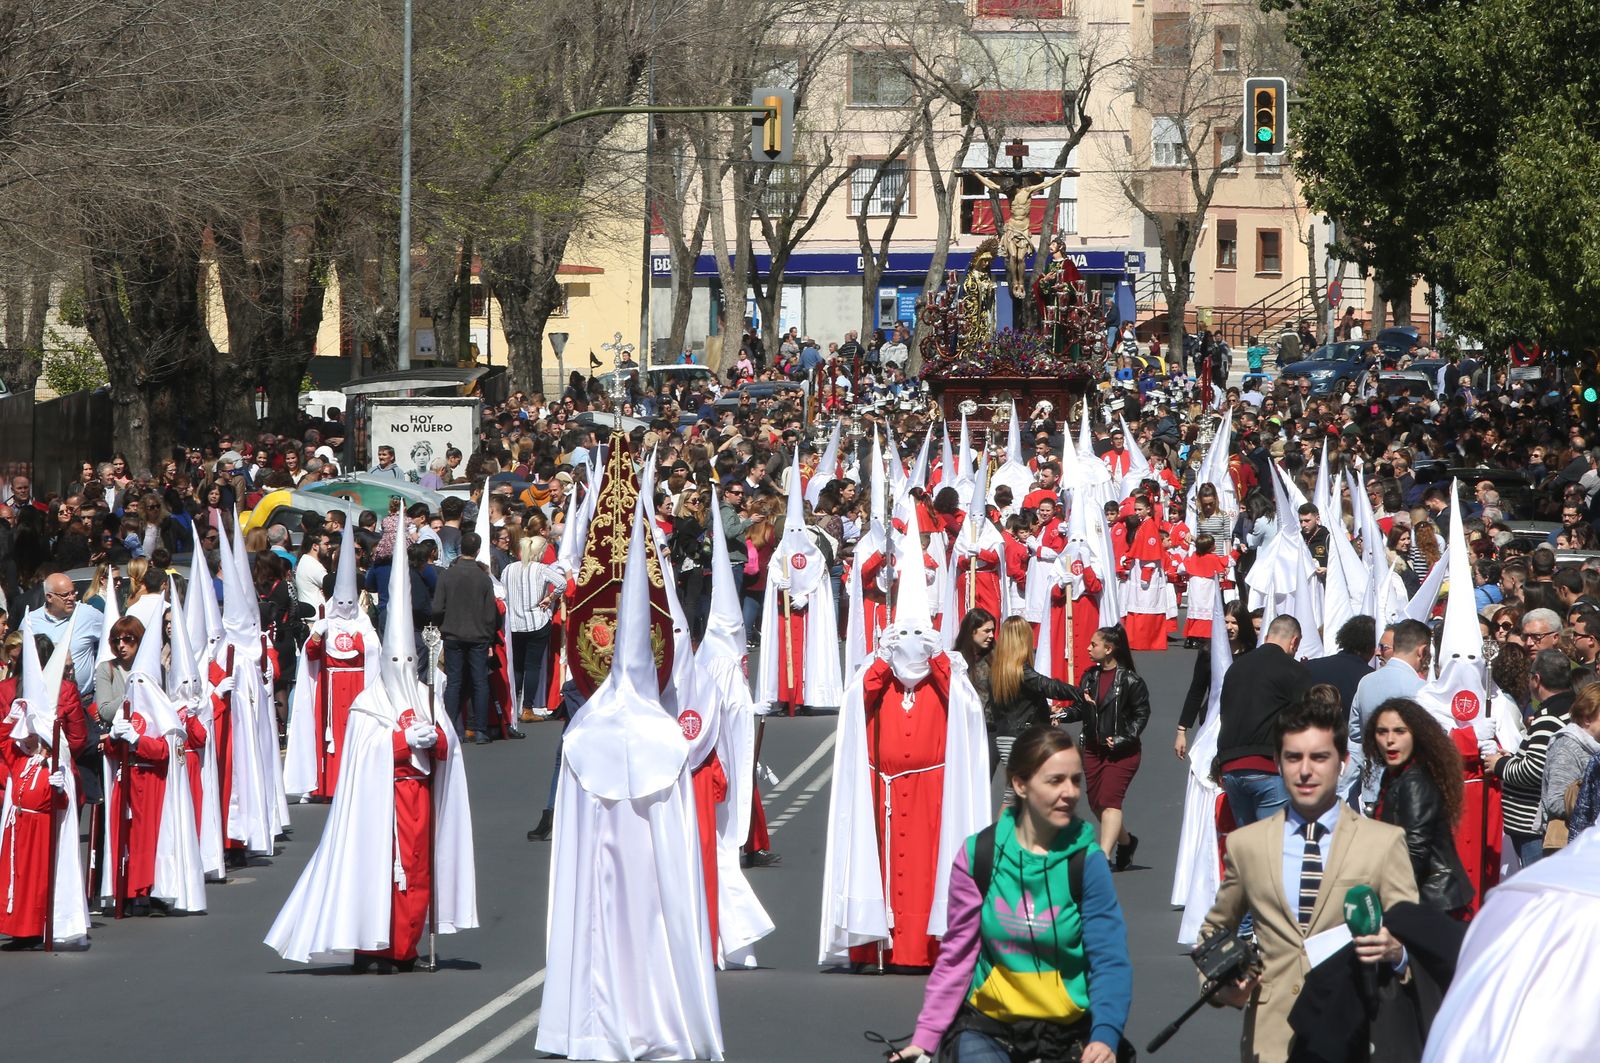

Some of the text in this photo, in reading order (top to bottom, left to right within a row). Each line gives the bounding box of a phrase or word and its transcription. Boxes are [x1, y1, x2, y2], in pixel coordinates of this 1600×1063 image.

[653, 258, 671, 271] BB
[410, 415, 434, 424] HOY
[391, 423, 453, 433] NO MUERO
